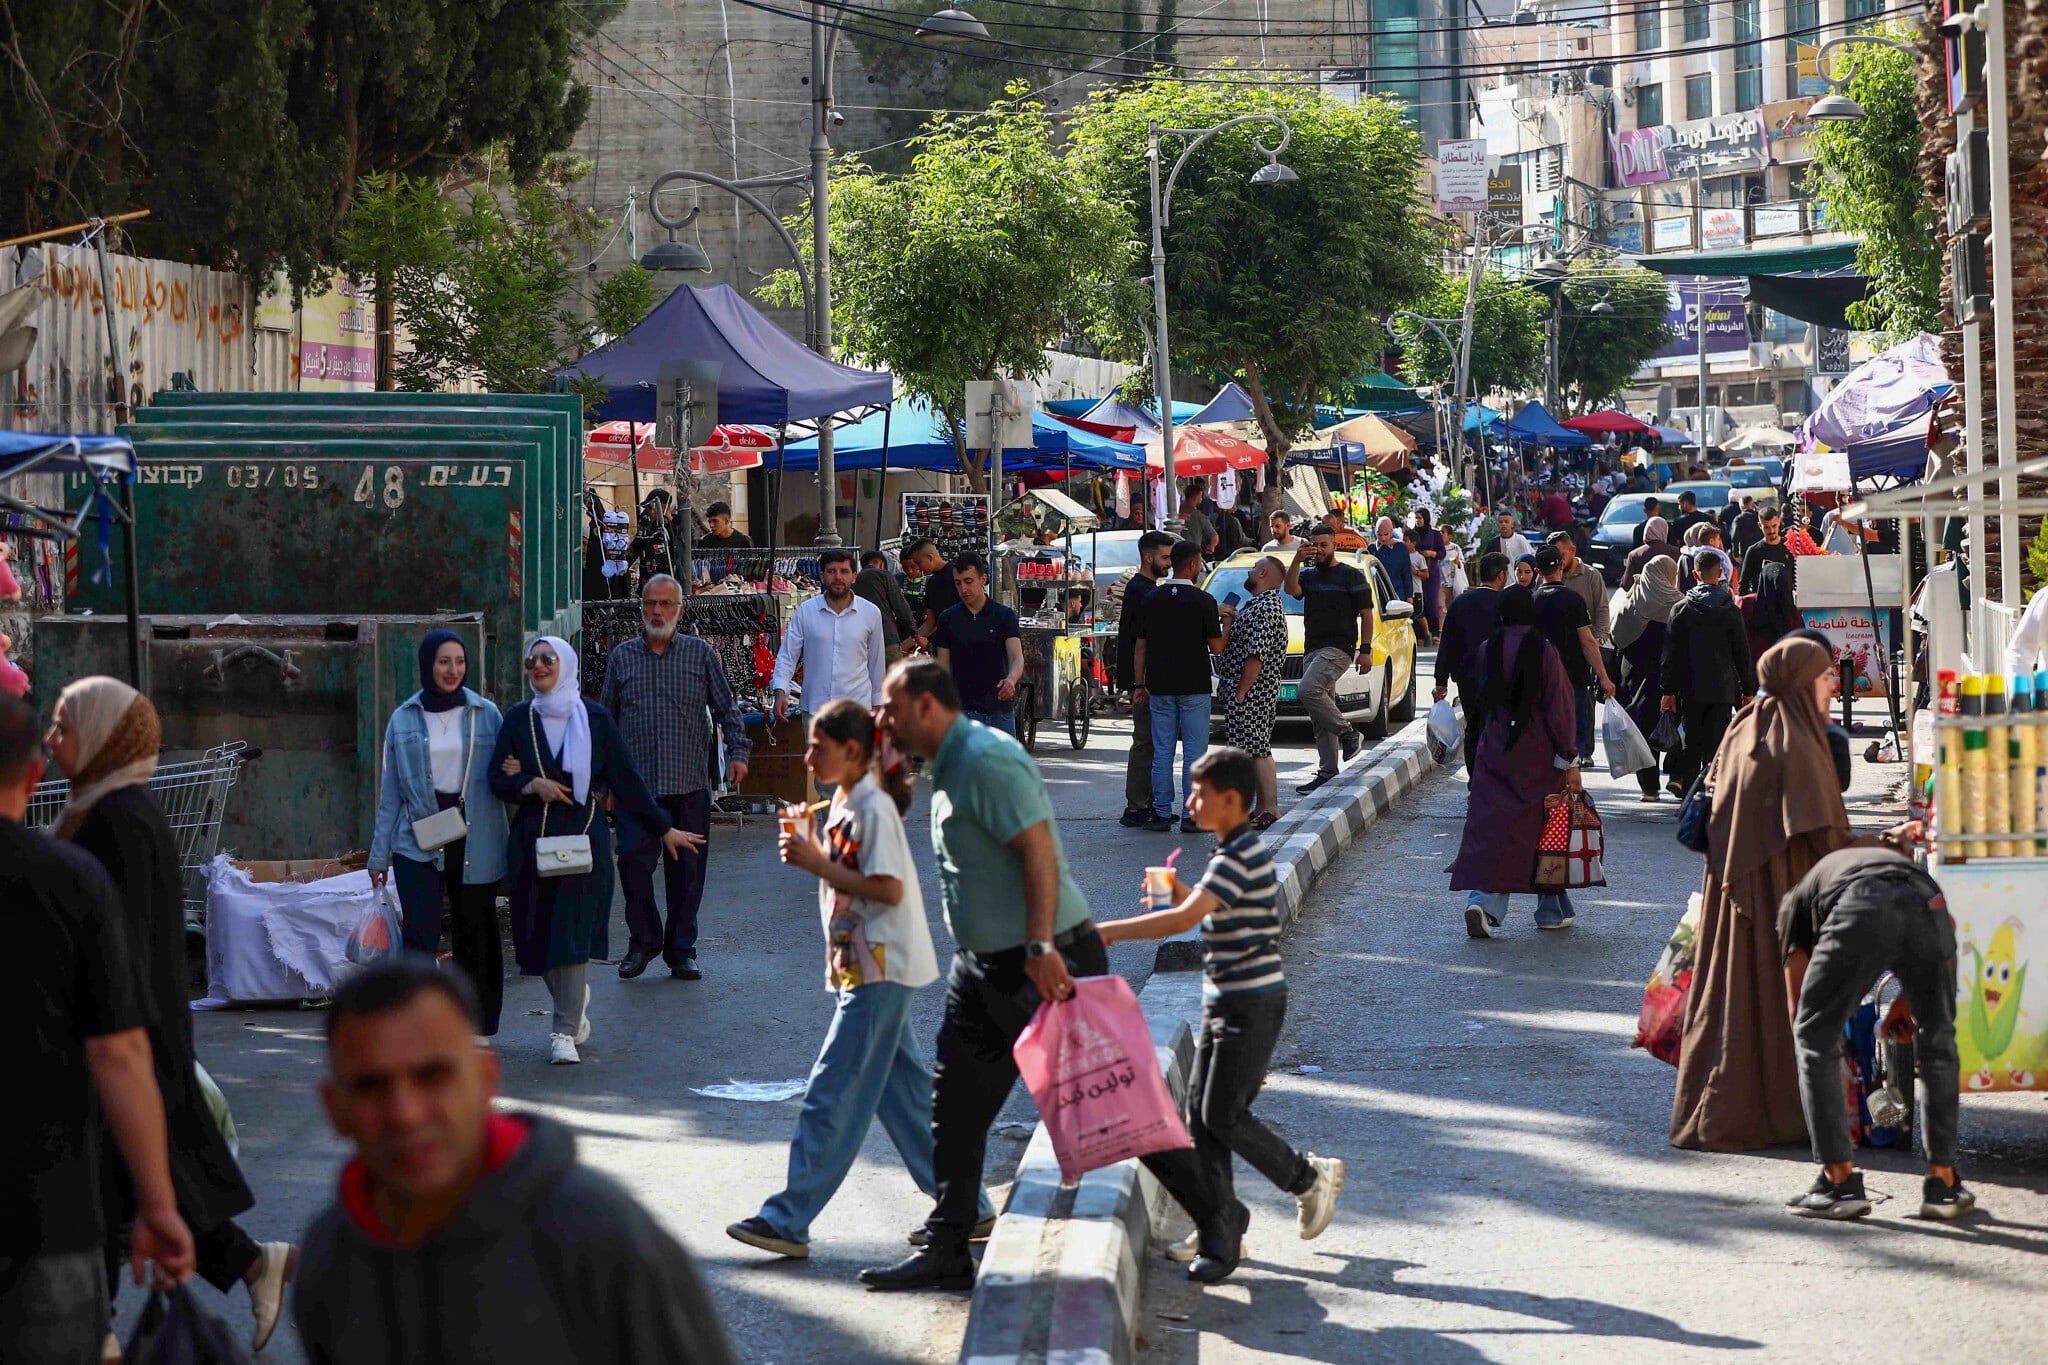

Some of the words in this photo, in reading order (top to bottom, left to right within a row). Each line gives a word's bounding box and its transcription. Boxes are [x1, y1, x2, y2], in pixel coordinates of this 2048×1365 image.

[1441, 151, 1469, 164] سلطان
[1471, 151, 1485, 165] يارا
[1488, 178, 1511, 188] الدك
[1720, 322, 1744, 334] الشريف
[302, 351, 320, 373] شيكل
[319, 345, 327, 376] 5
[332, 355, 343, 376] جينز
[227, 465, 319, 489] 03/05
[353, 465, 405, 509] 48
[1808, 616, 1848, 630] شامية
[1851, 616, 1884, 630] بظة
